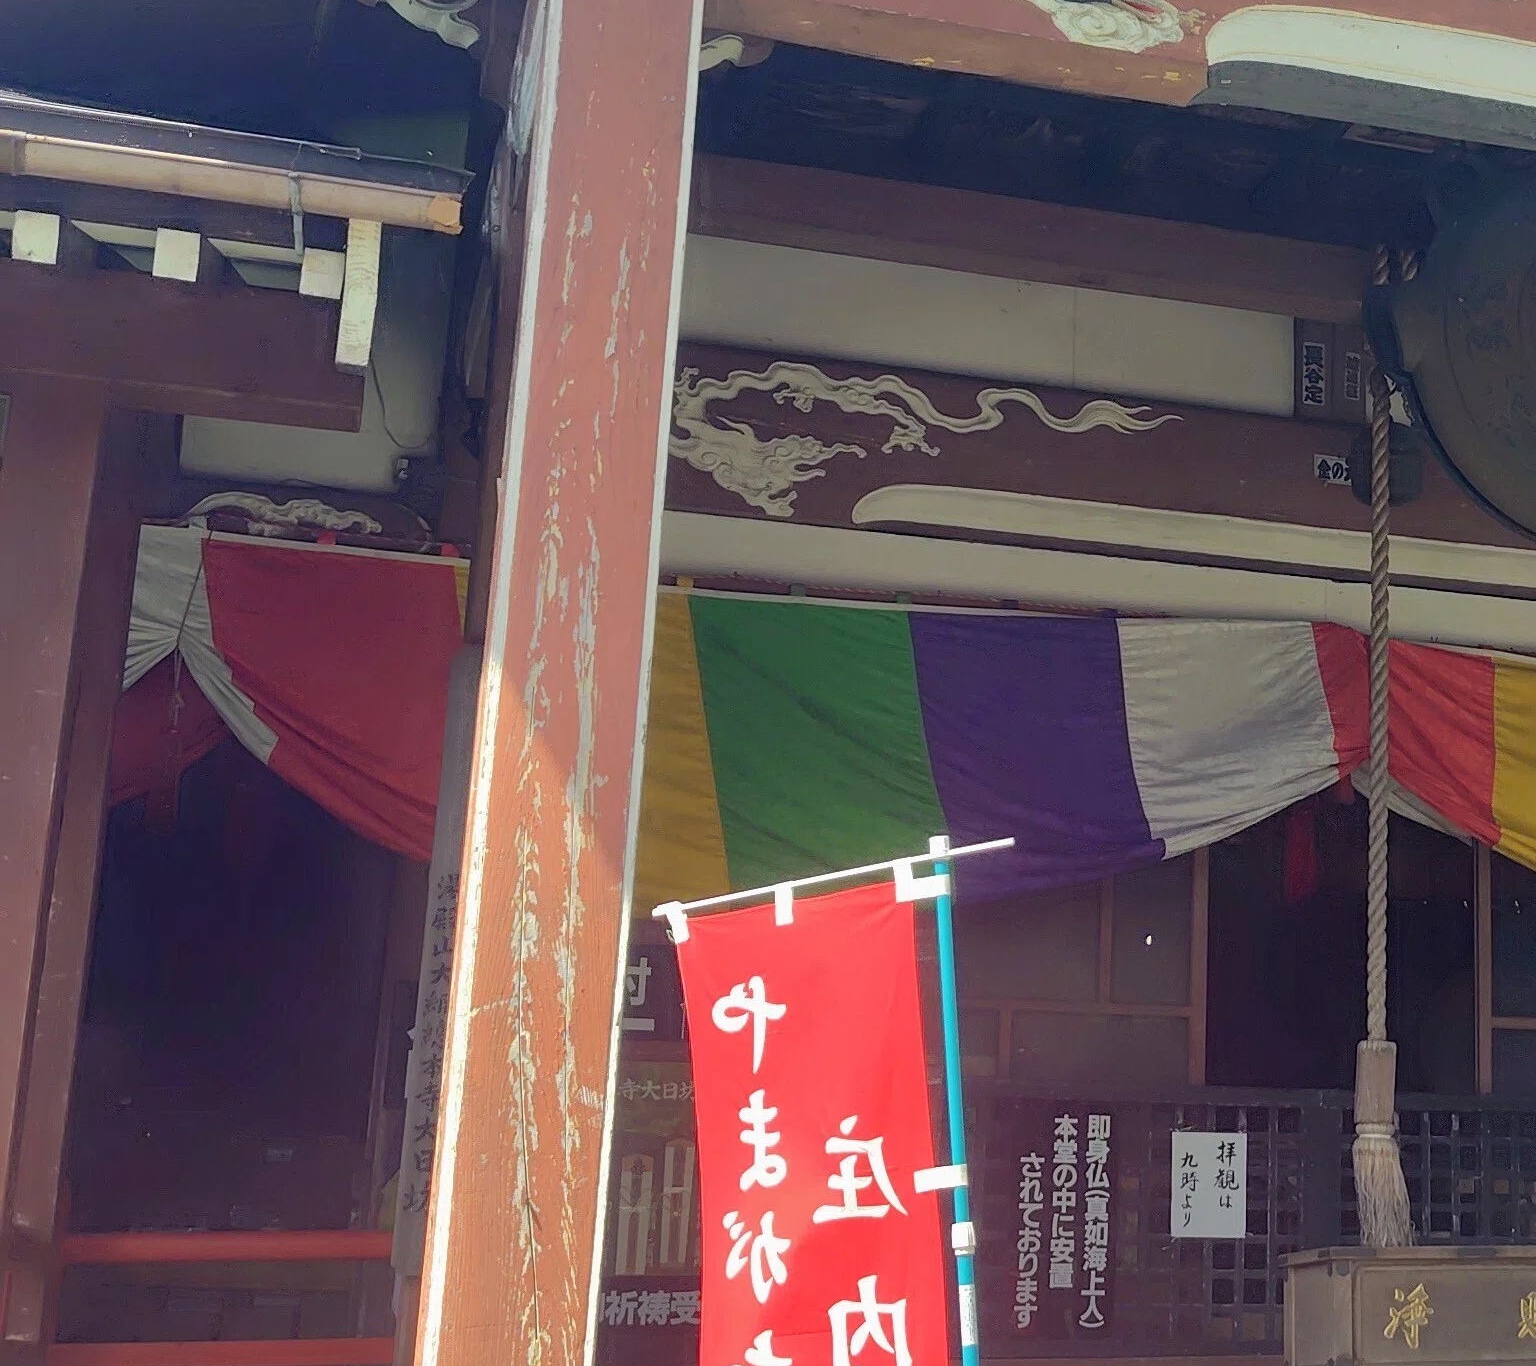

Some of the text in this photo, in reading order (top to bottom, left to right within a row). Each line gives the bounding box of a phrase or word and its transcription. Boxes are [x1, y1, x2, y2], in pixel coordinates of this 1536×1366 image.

[1048, 1113, 1079, 1289] 本堂の中に安置
[1078, 1114, 1112, 1329] 即身仏（真如海上人）
[1179, 1151, 1200, 1228] 九時より
[1213, 1140, 1240, 1209] 拝観は
[1013, 1151, 1046, 1329] されております
[600, 1290, 700, 1326] 祈祷受
